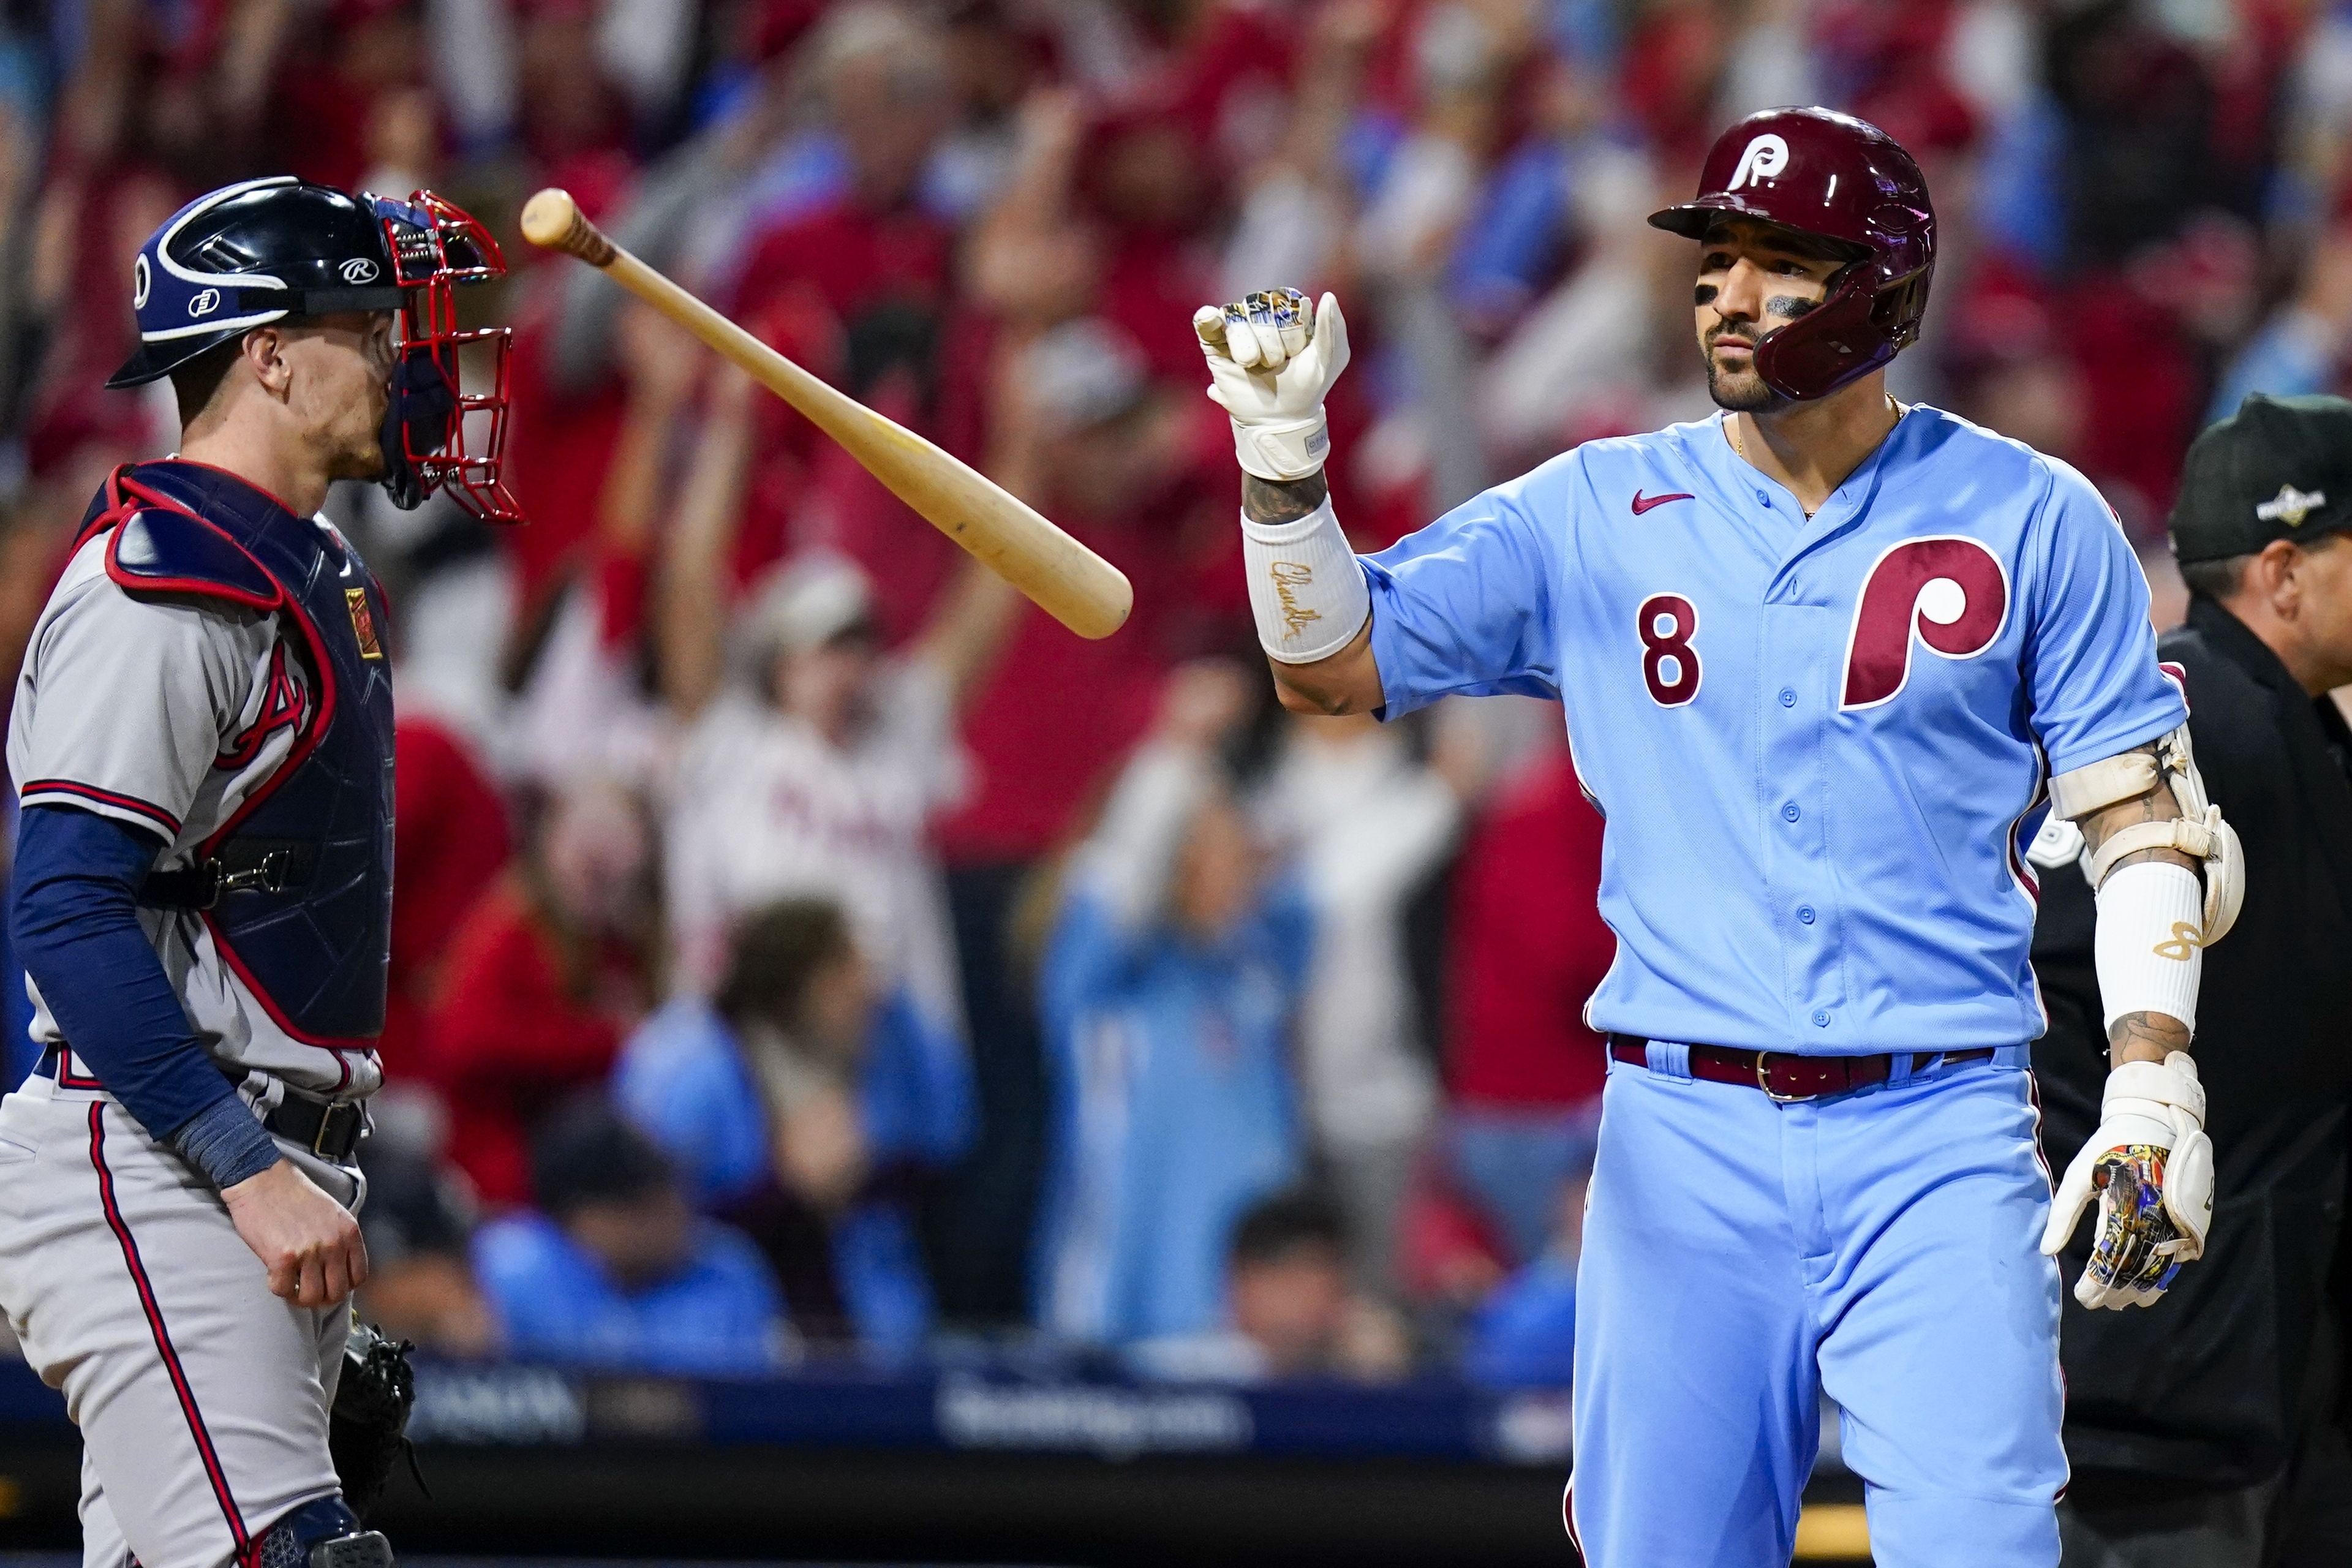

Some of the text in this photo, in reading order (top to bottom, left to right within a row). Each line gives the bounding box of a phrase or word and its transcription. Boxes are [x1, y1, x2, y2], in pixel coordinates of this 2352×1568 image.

[1727, 134, 1790, 191] P
[341, 258, 377, 284] R
[1636, 592, 1703, 709] 8
[1838, 534, 2011, 712] P
[214, 636, 306, 771] A
